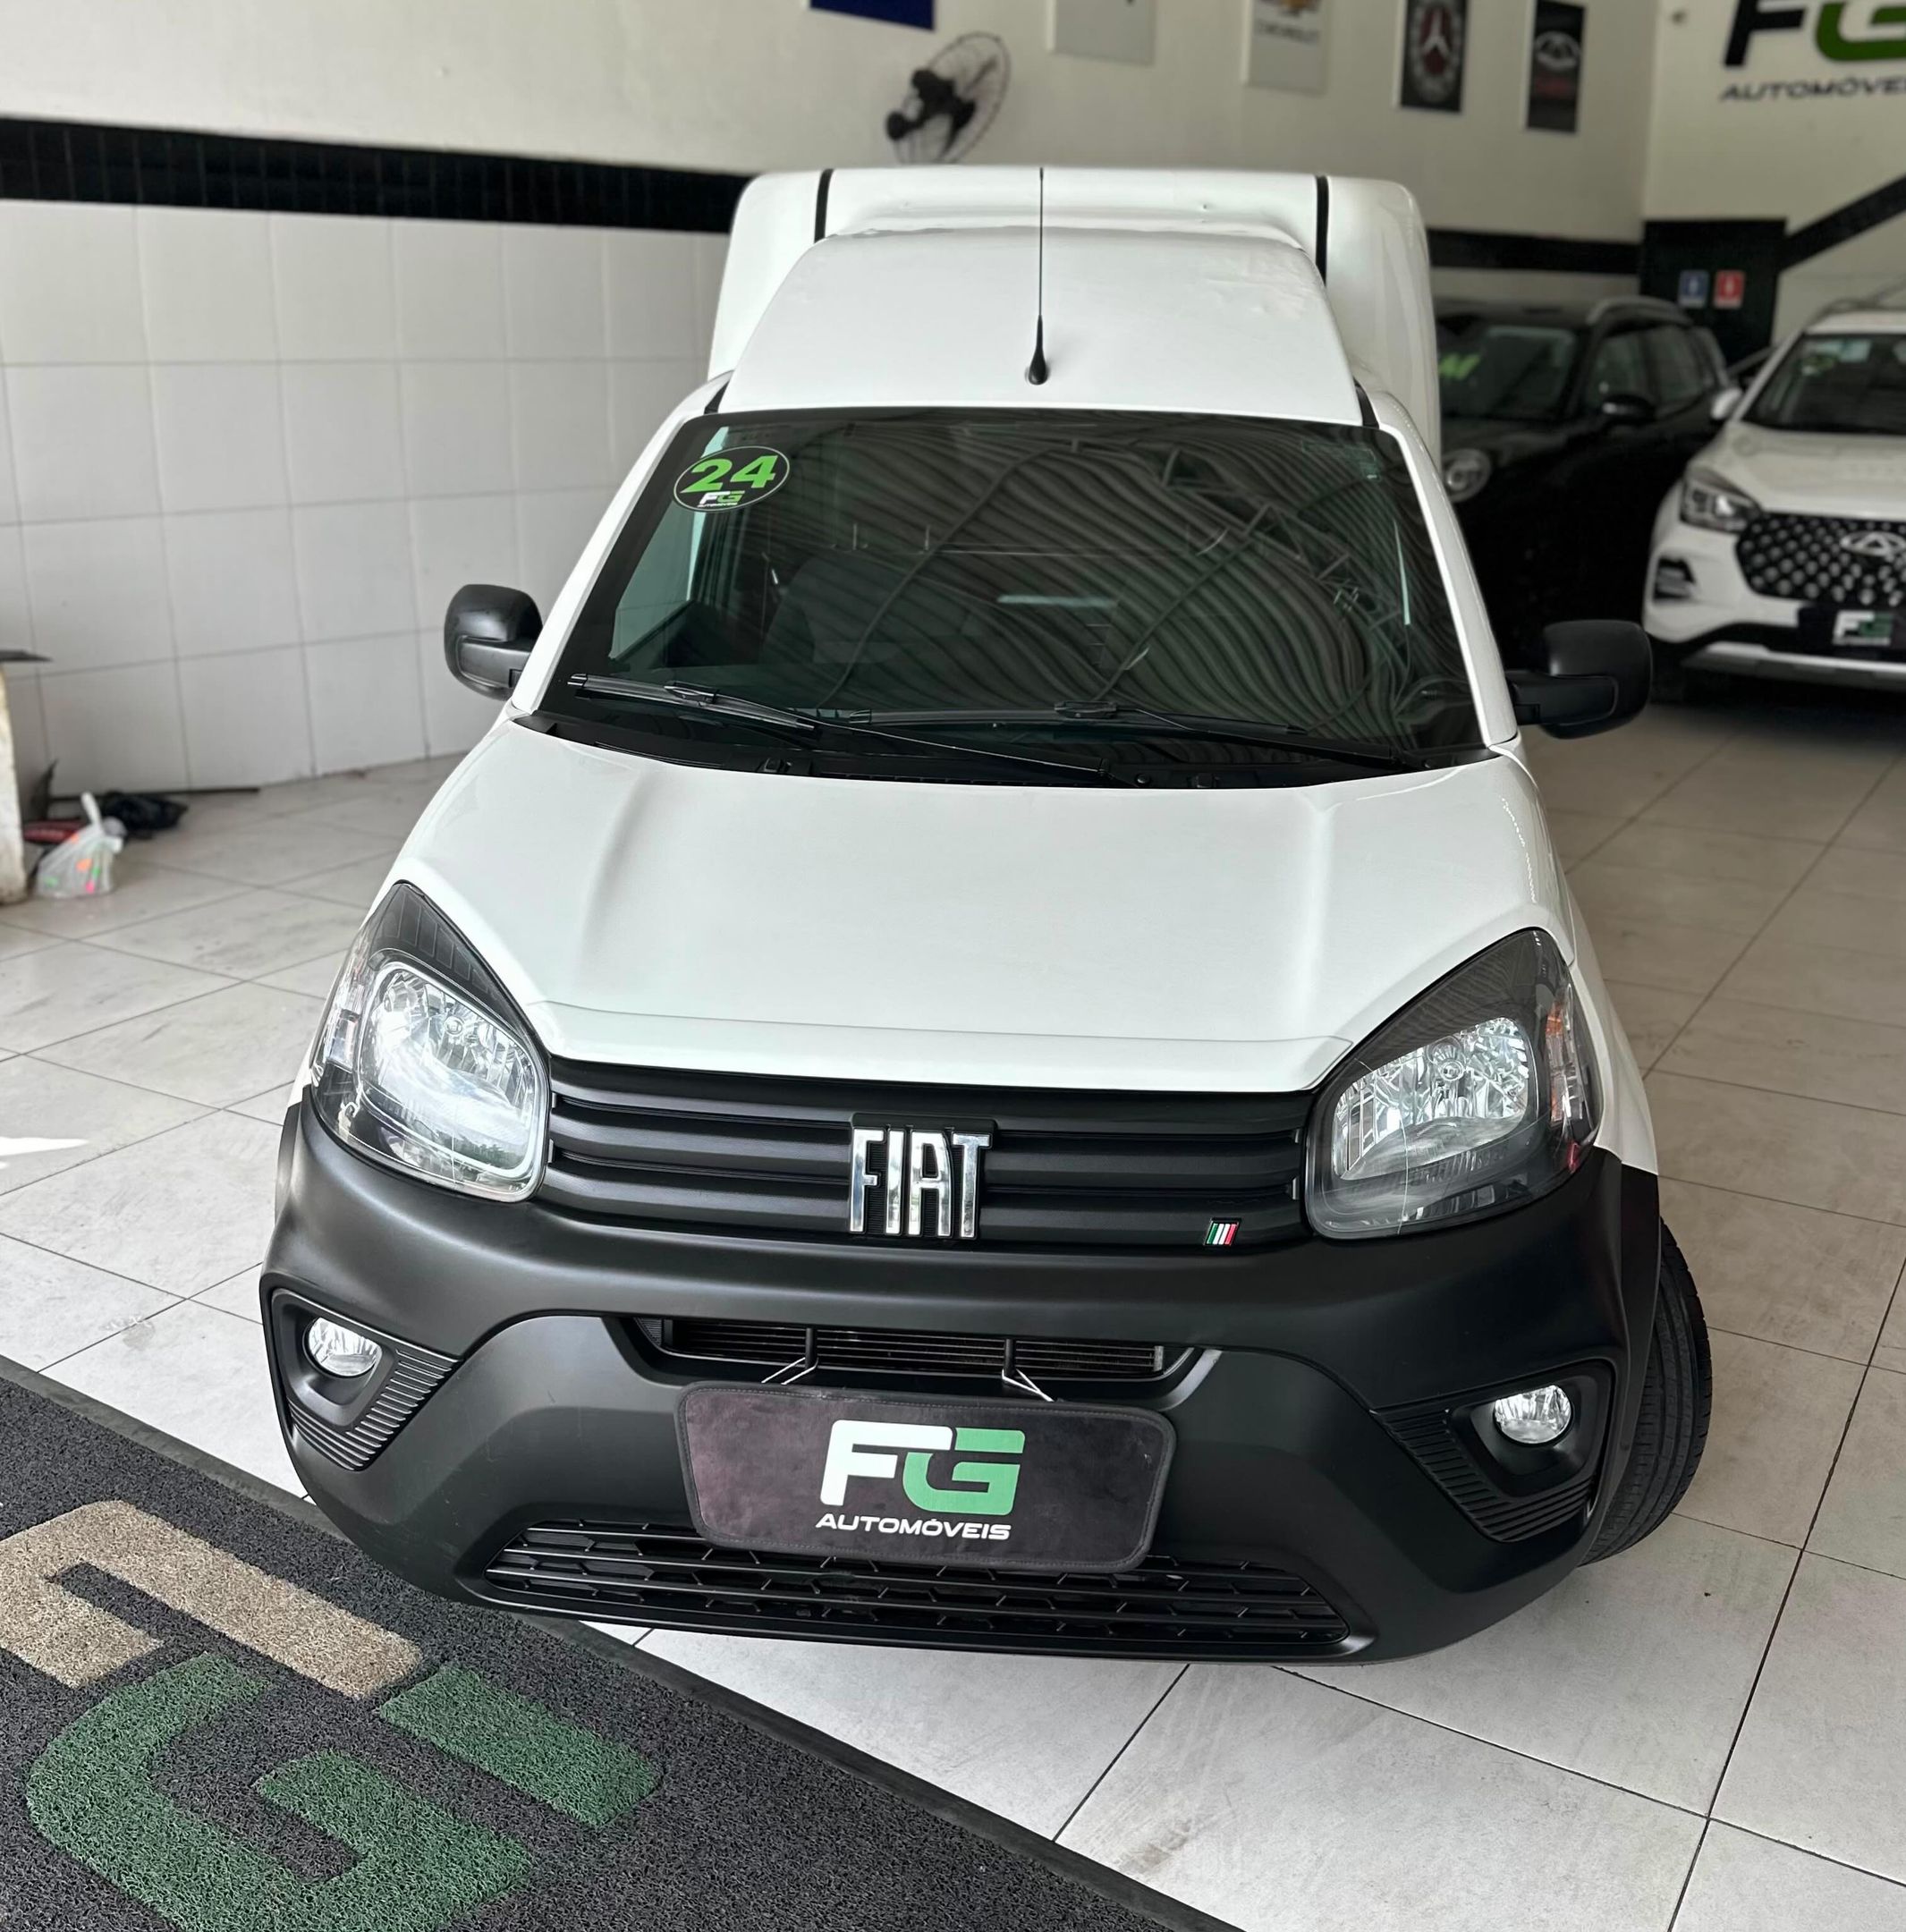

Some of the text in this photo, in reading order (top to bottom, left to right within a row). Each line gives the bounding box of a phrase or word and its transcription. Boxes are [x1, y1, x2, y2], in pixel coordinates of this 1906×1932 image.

[1723, 75, 1906, 102] AUTOMÓVE
[680, 454, 778, 493] 24
[699, 490, 745, 505] FG
[850, 1128, 991, 1239] FIAT
[819, 1419, 1026, 1516] FG
[815, 1512, 1012, 1541] AUTOMÓVEIS
